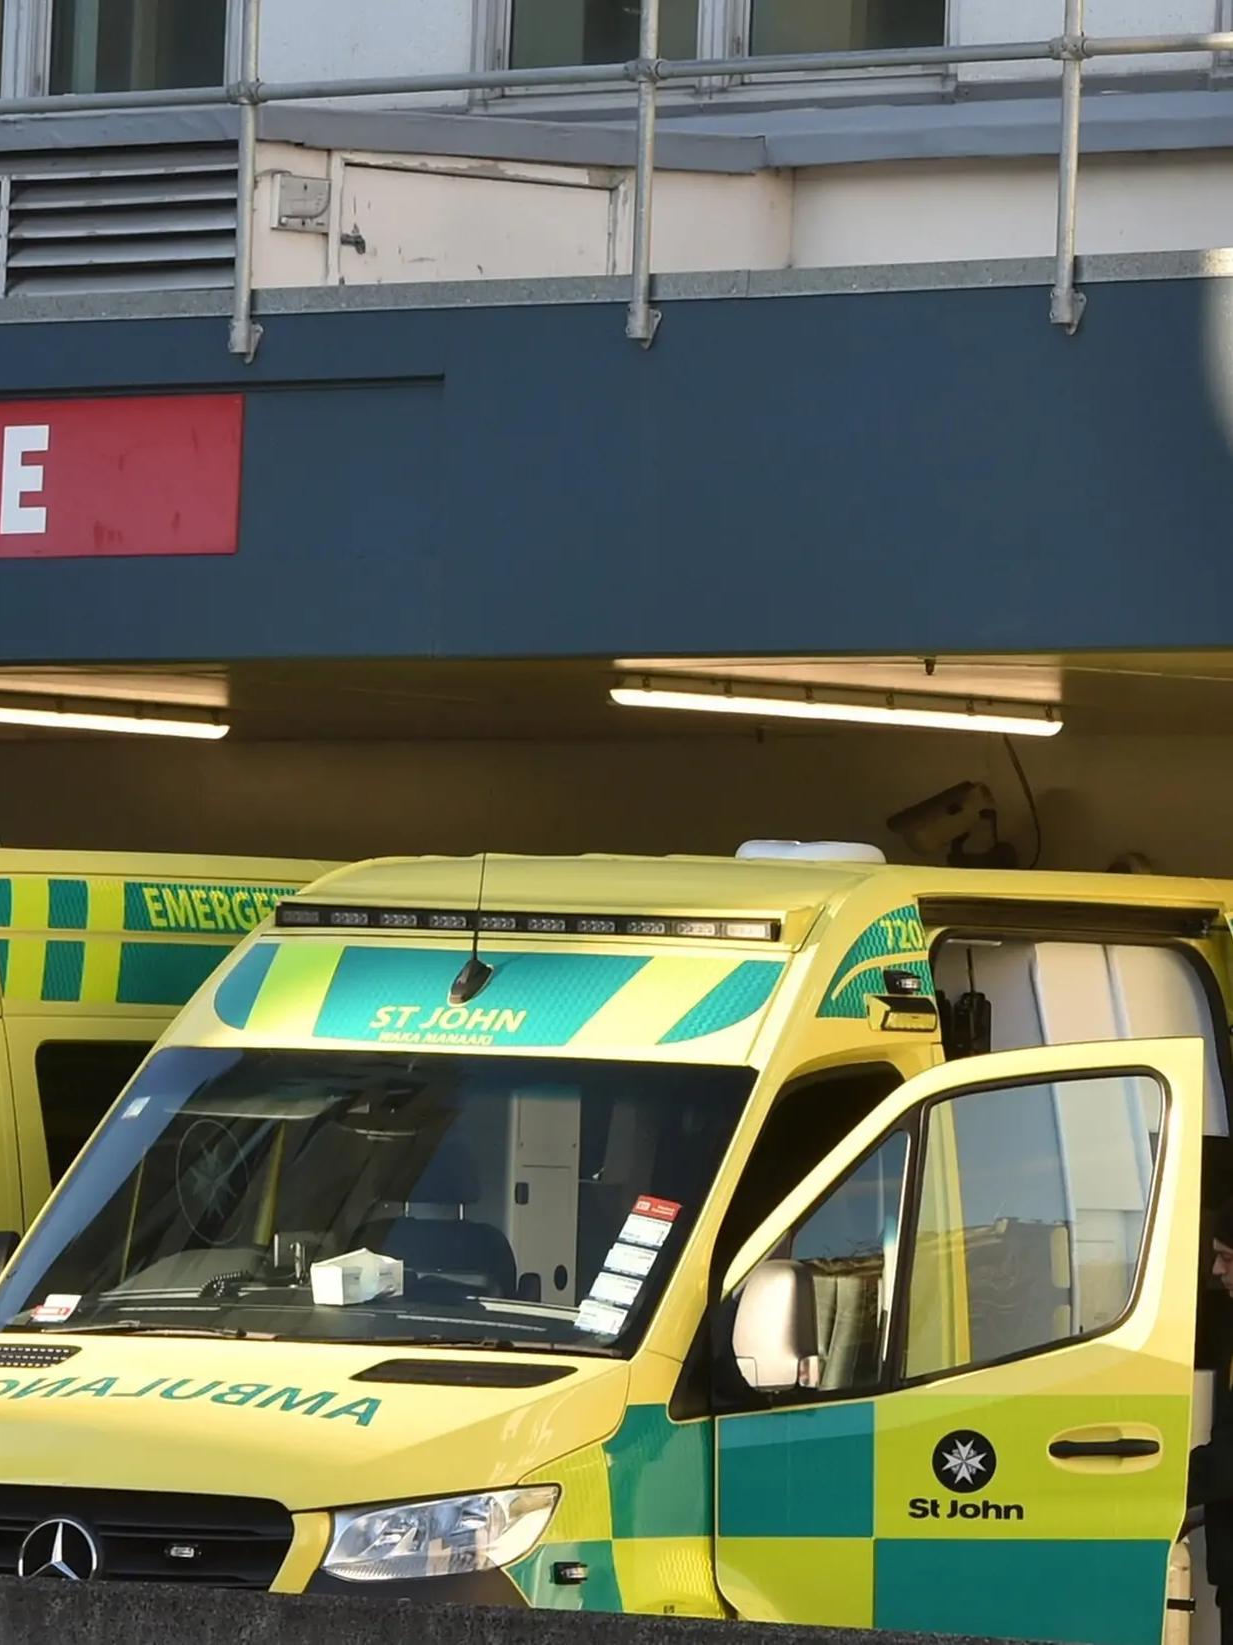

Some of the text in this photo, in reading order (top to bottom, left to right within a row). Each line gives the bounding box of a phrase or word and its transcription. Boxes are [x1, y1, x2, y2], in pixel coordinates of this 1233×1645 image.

[142, 887, 279, 931] EMERGE
[880, 918, 924, 950] 720
[369, 1005, 526, 1032] ST JOHN
[908, 1498, 1024, 1520] St John
